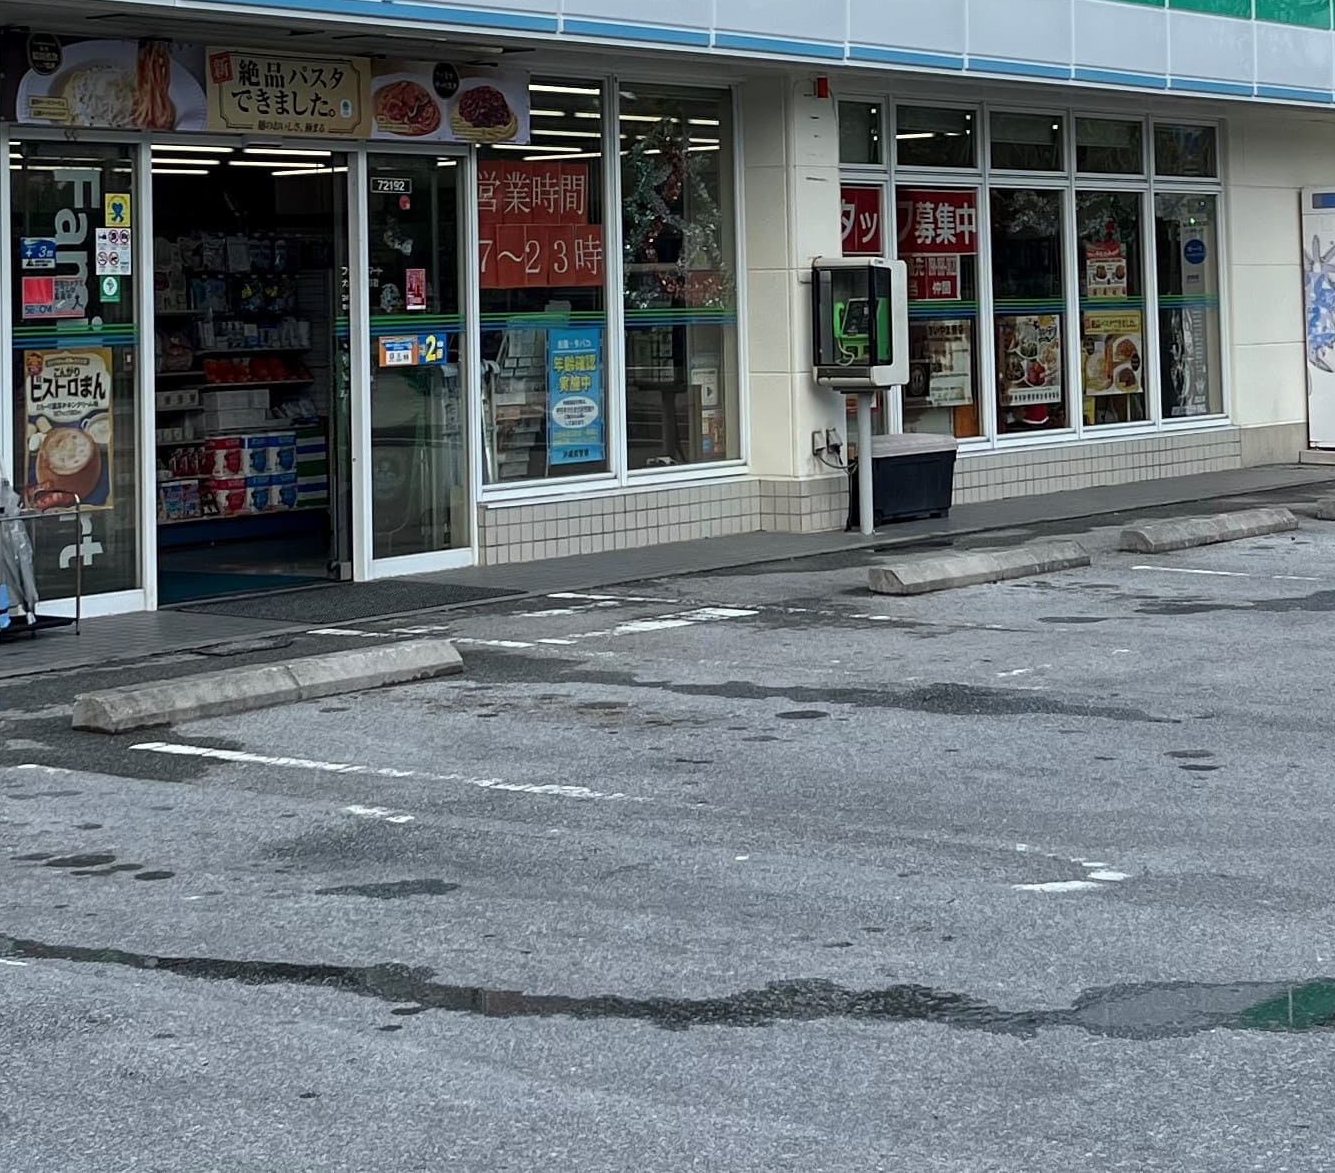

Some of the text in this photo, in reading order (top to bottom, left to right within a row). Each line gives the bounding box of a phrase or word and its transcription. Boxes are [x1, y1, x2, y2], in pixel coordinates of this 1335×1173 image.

[215, 54, 231, 81] 新
[238, 60, 345, 90] 絶品パスタ
[232, 88, 337, 119] できました。
[477, 170, 586, 215] 営業時間
